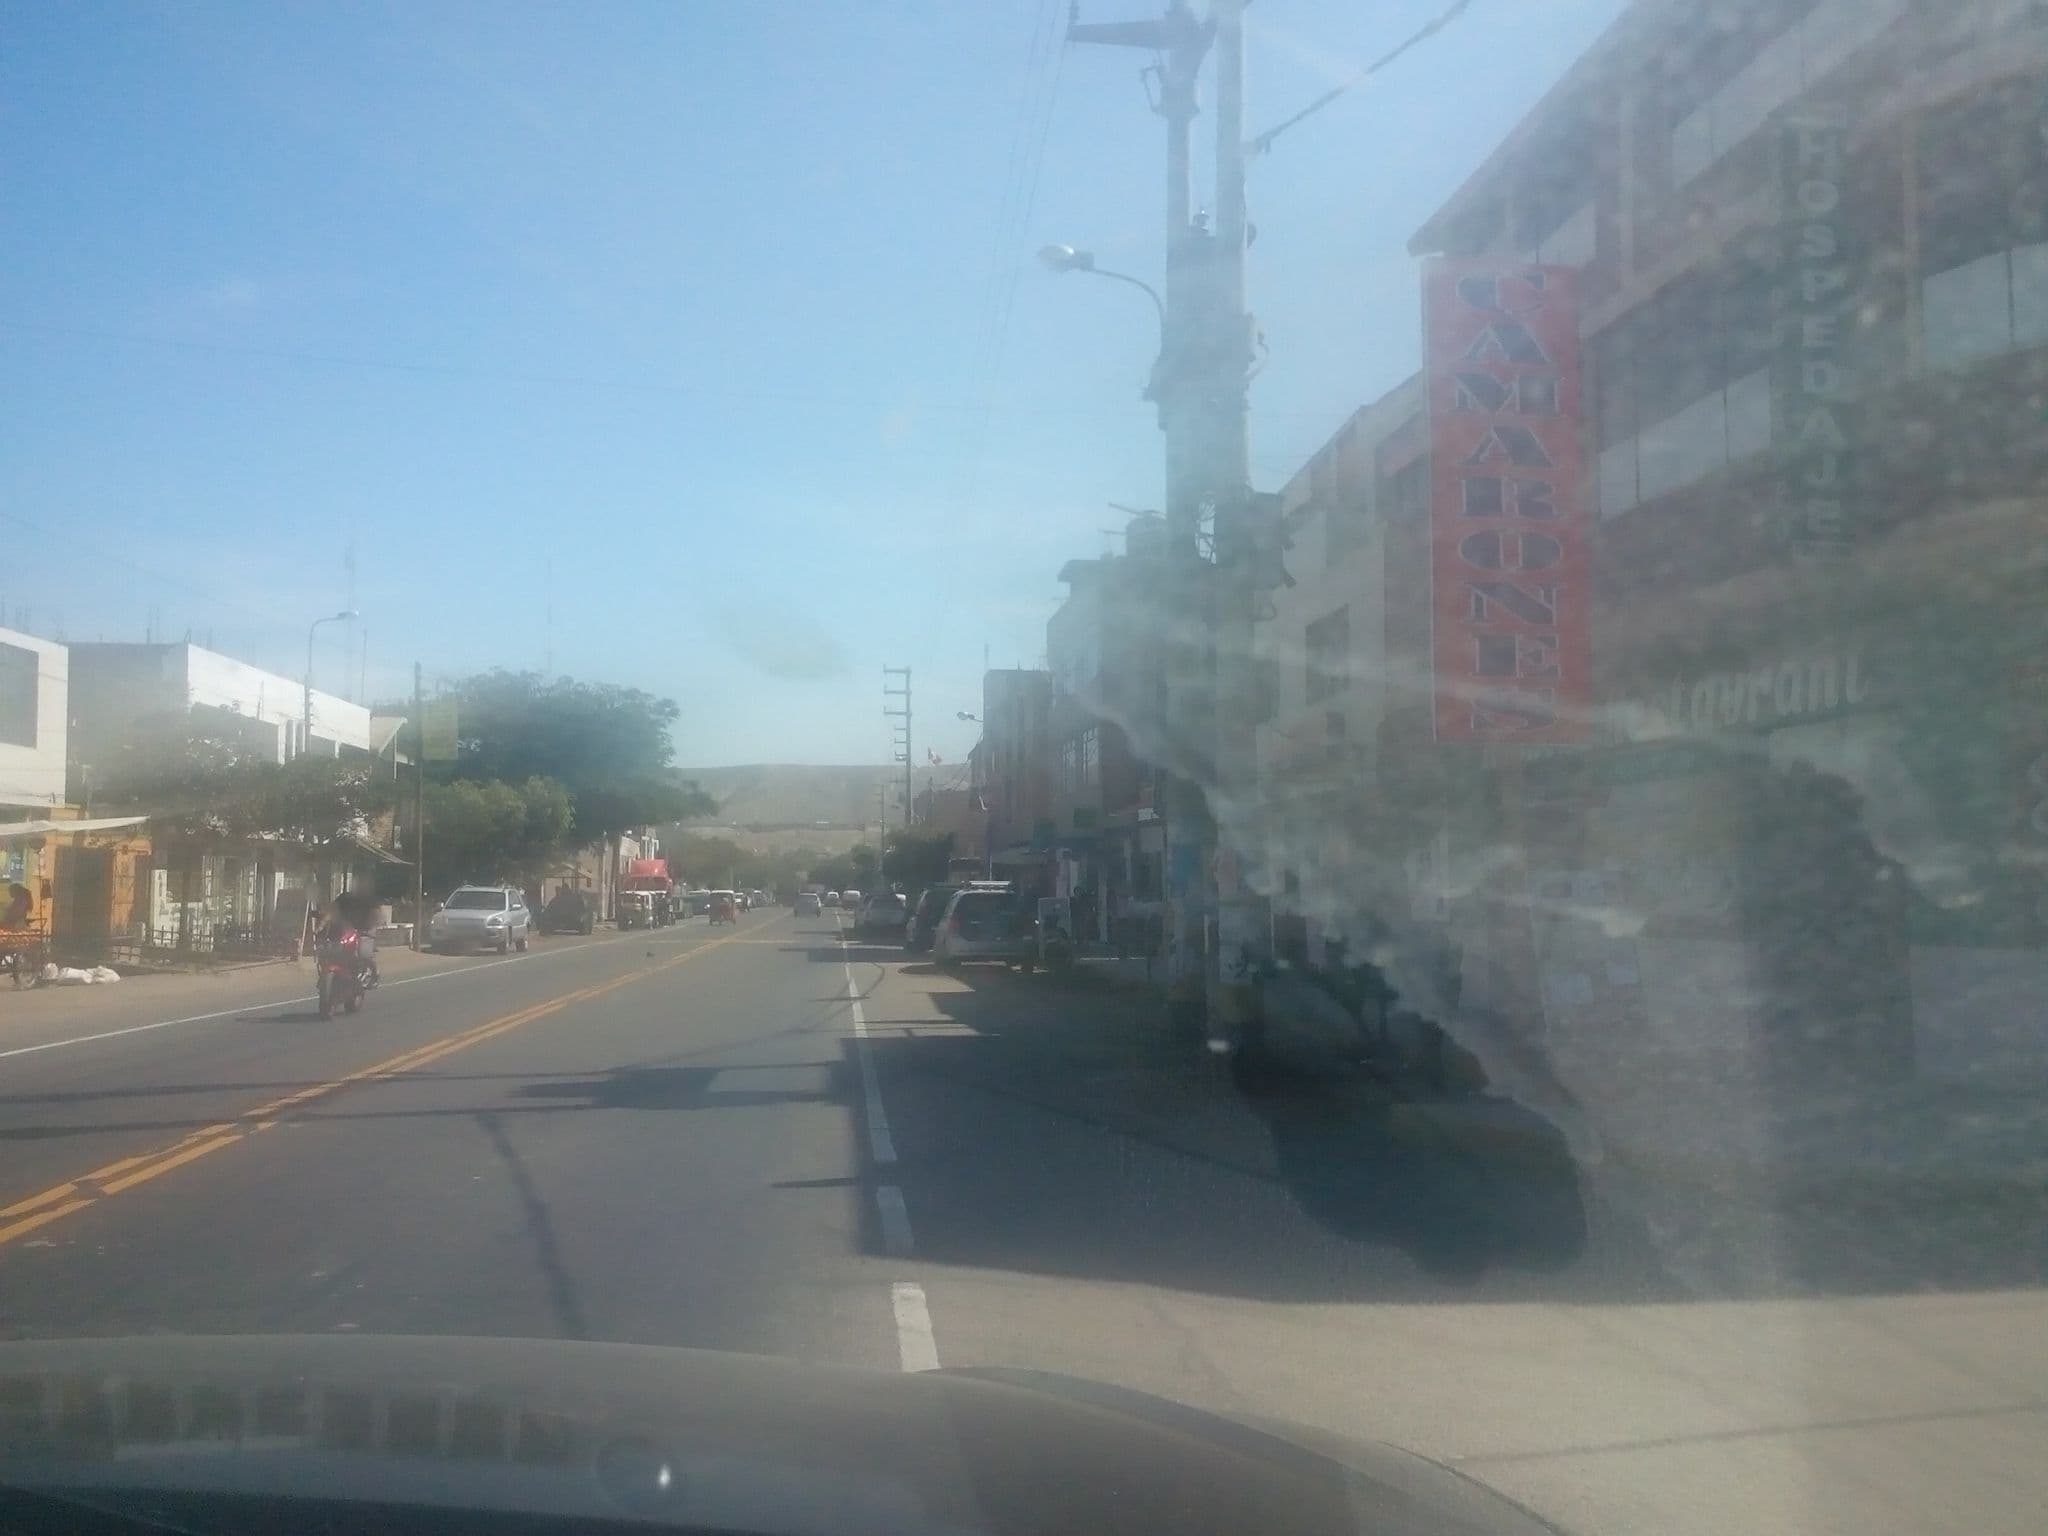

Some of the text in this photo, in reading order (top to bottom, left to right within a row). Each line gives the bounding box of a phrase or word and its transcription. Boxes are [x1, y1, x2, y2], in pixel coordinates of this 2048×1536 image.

[1455, 270, 1566, 731] CAMARONES
[1797, 128, 1848, 534] HOSPEDAJE
[1597, 650, 1873, 742] taurant
